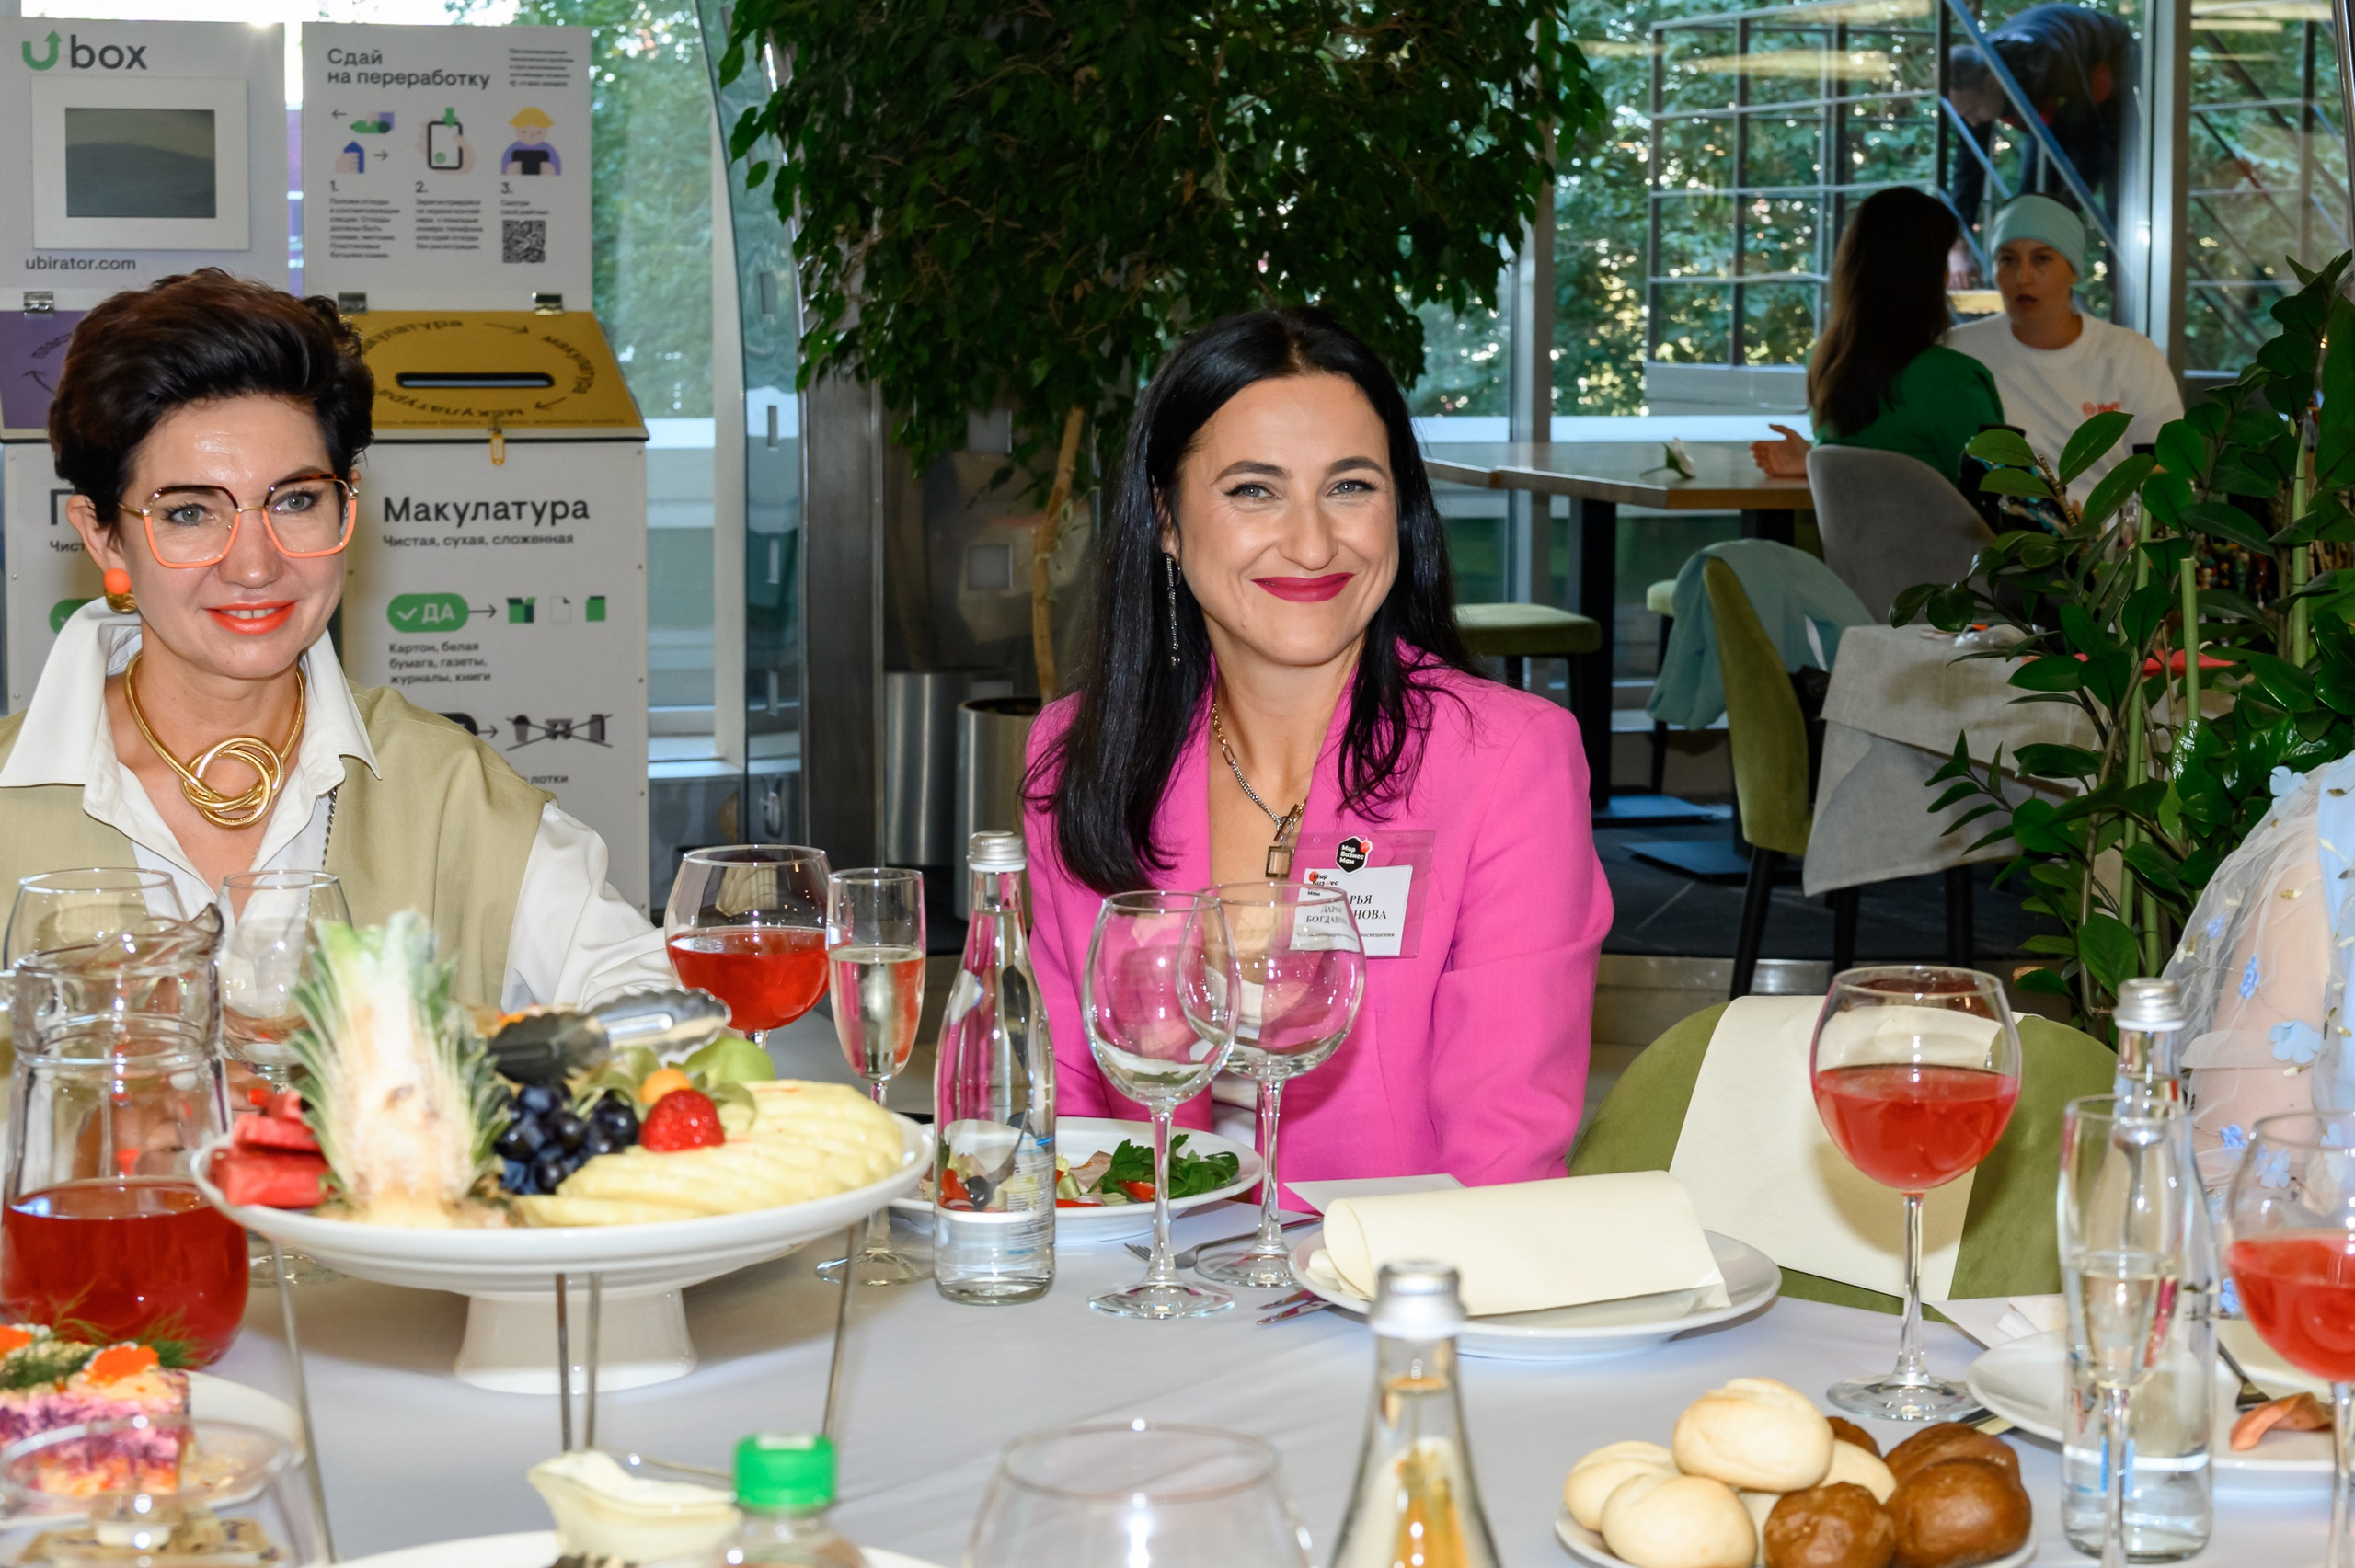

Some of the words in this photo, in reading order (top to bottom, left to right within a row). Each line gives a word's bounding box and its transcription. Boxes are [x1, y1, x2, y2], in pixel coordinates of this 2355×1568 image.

[327, 48, 383, 65] Сдай
[327, 72, 351, 85] на
[358, 69, 490, 90] переработку
[330, 181, 339, 193] 1.
[416, 181, 429, 193] 2.
[500, 182, 513, 194] 3.
[26, 255, 136, 270] ubirator.com
[384, 496, 590, 528] Макулатура
[384, 534, 440, 547] Чистая,
[443, 534, 488, 547] сухая,
[492, 533, 573, 545] сложенная
[422, 603, 455, 624] ДА
[390, 642, 439, 655] Картон,
[442, 641, 479, 652] белая
[390, 656, 438, 670] бумага,
[441, 658, 487, 668] газеты,
[390, 672, 452, 685] журналы,
[455, 671, 491, 682] книги
[531, 774, 569, 784] лотки
[1340, 851, 1364, 860] Бизнес
[1341, 844, 1356, 853] Мир
[1350, 894, 1373, 905] РЬЯ
